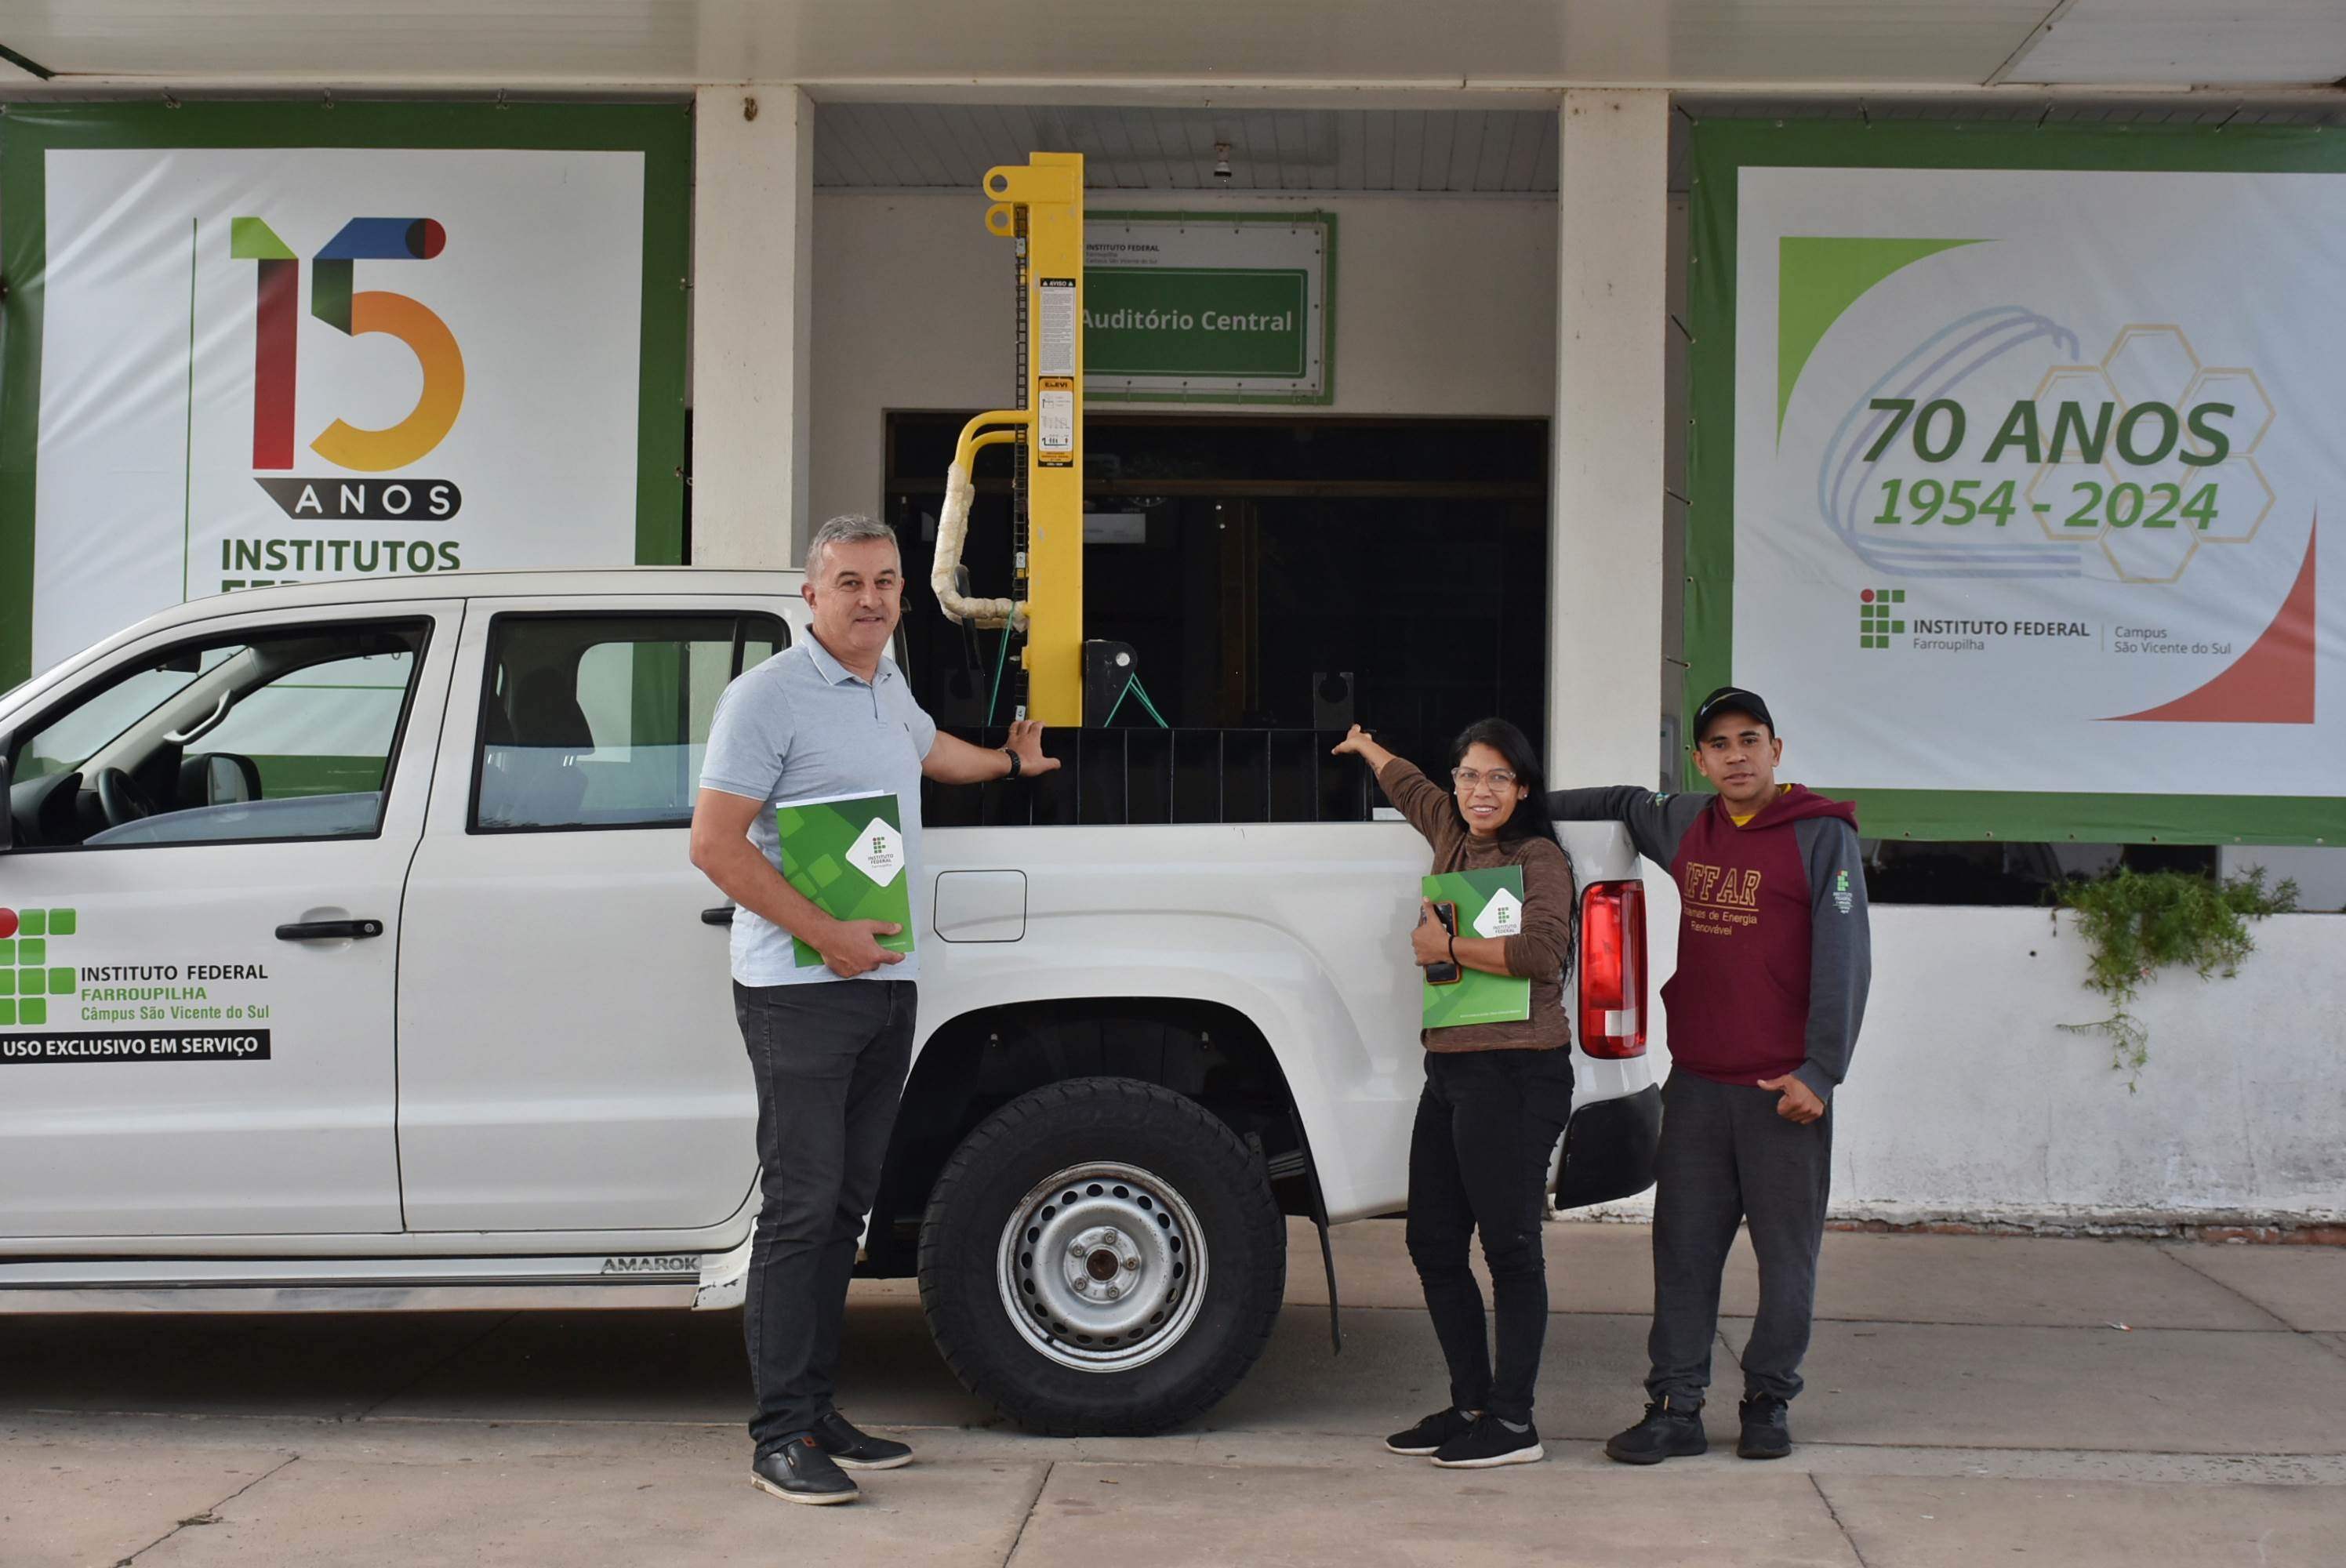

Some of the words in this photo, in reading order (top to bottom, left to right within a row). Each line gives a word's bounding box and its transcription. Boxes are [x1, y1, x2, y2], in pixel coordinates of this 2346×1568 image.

[1082, 309, 1194, 330] Auditório
[1201, 311, 1292, 332] Central
[230, 216, 466, 473] 15
[1863, 398, 1966, 463] 70
[1981, 400, 2235, 467] ANOS
[296, 484, 451, 515] ANOS
[1873, 478, 2017, 527] 1954
[2063, 481, 2219, 530] 2024
[222, 539, 461, 573] INSTITUTOS
[1913, 619, 2008, 636] INSTITUTO
[2014, 622, 2090, 637] FEDERAL
[2115, 626, 2168, 641] Campus
[1913, 637, 1985, 652] Farroupilha
[2115, 641, 2138, 653] São
[2141, 641, 2188, 654] Vicente
[2191, 642, 2208, 654] do
[2211, 642, 2232, 655] Sul
[1684, 861, 1762, 906] IFFAR
[1709, 910, 1720, 920] de
[1722, 912, 1757, 926] Energia
[1690, 920, 1732, 936] Renovável
[81, 966, 178, 982] INSTITUTO
[187, 964, 269, 979] FEDERAL
[81, 986, 207, 1001] FARROUPILHA
[81, 1007, 136, 1023] Câmpus
[140, 1005, 165, 1020] São
[170, 1005, 221, 1019] Vicente
[226, 1004, 243, 1018] do
[248, 1004, 270, 1018] Sul
[3, 1040, 42, 1057] USO
[46, 1039, 146, 1056] EXCLUSIVO
[151, 1037, 177, 1054] EM
[181, 1036, 258, 1056] SERVIÇO
[601, 1257, 699, 1272] AMAROK
